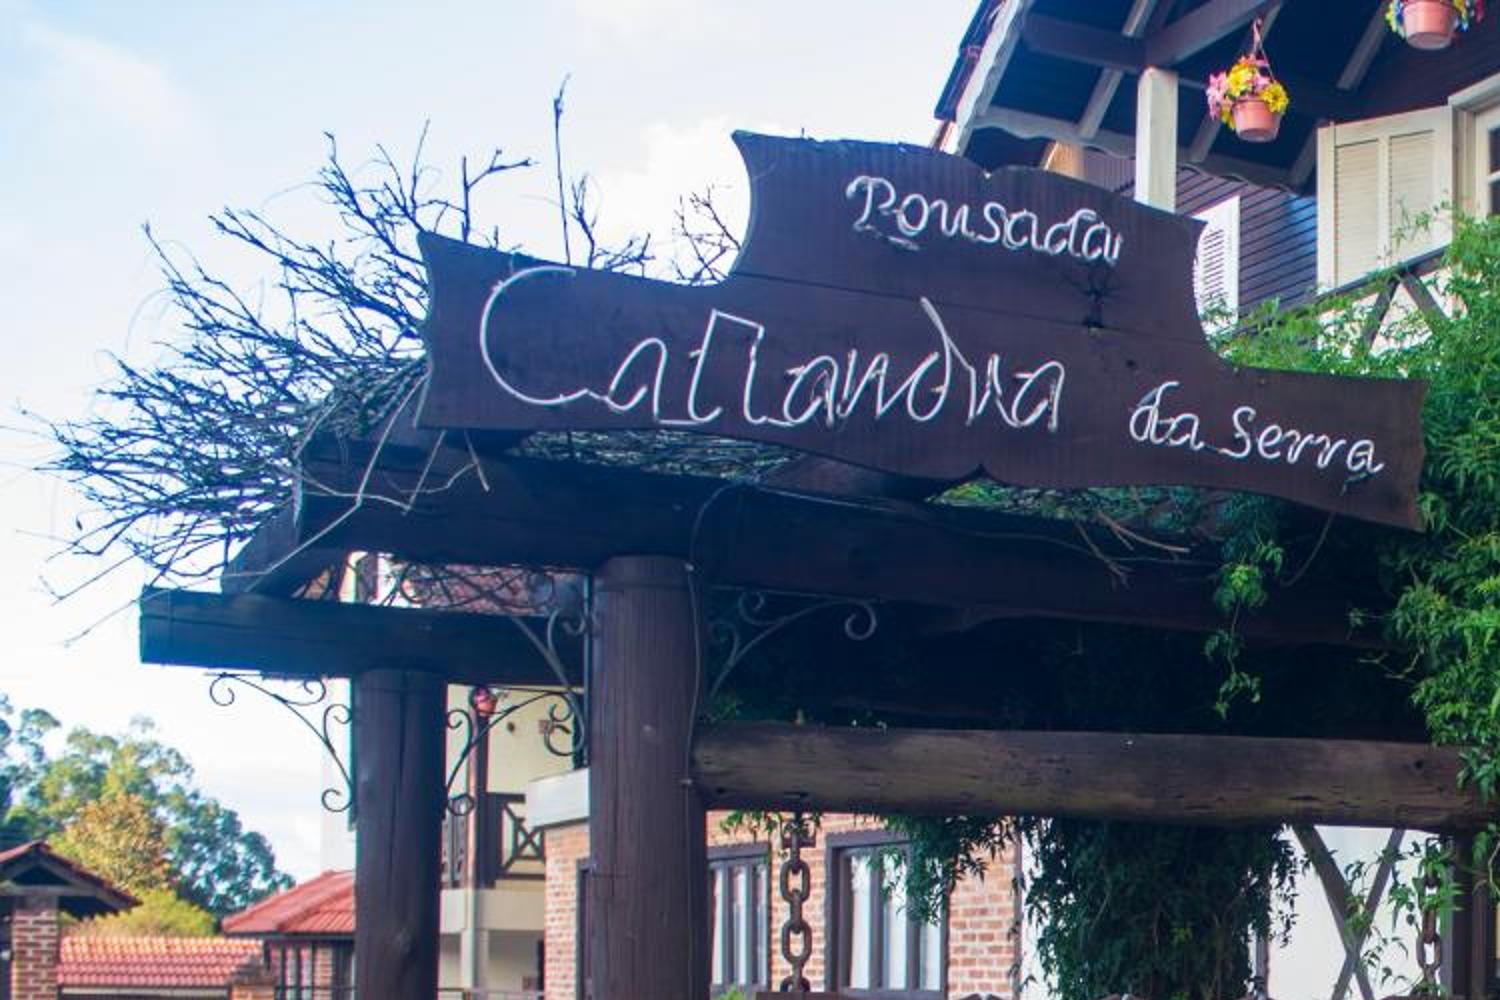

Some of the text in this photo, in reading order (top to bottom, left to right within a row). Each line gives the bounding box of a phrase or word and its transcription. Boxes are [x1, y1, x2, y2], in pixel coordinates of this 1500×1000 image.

[847, 174, 1124, 267] Pousada
[1130, 380, 1207, 453] da
[1218, 399, 1386, 476] Serra
